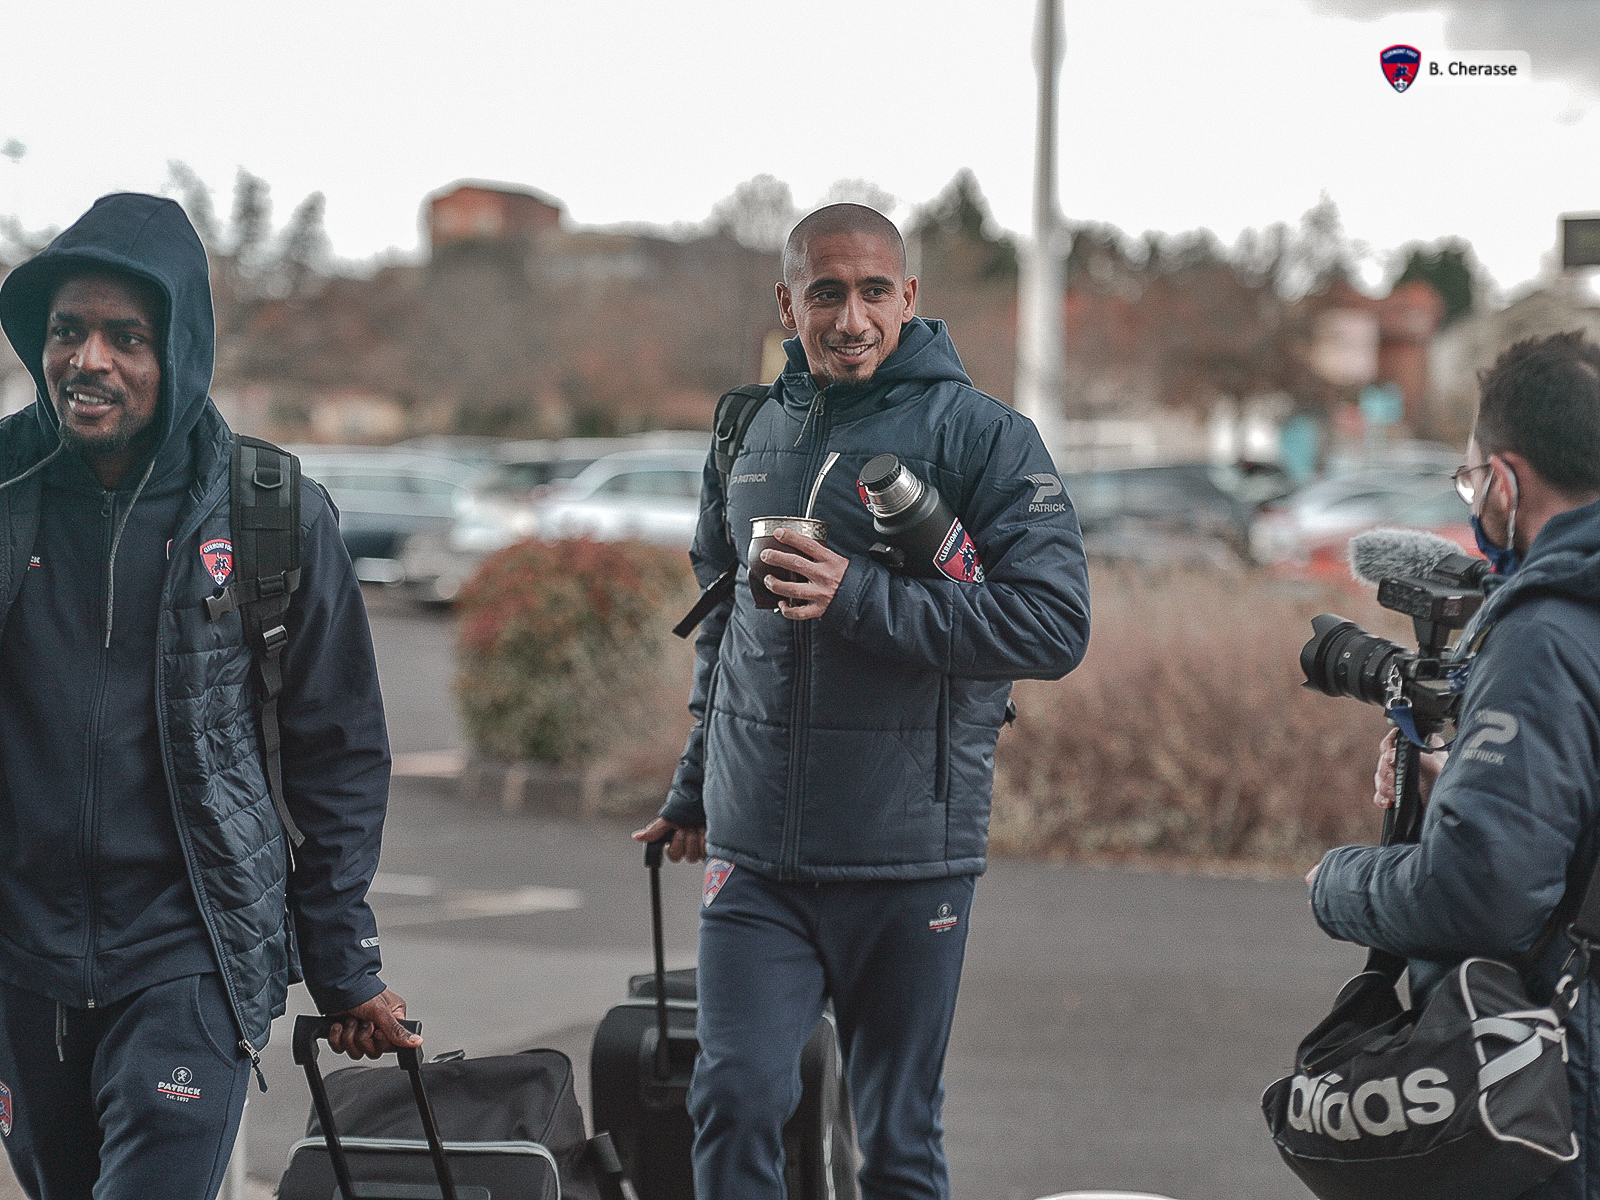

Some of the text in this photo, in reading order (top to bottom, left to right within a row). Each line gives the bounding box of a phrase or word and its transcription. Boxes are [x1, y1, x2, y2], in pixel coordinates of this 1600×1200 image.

[738, 473, 767, 484] PATRICK
[1028, 503, 1066, 513] PATRICK
[203, 542, 225, 554] CLERMONT
[939, 528, 959, 562] CLERMONT
[157, 1081, 201, 1096] PATRICK
